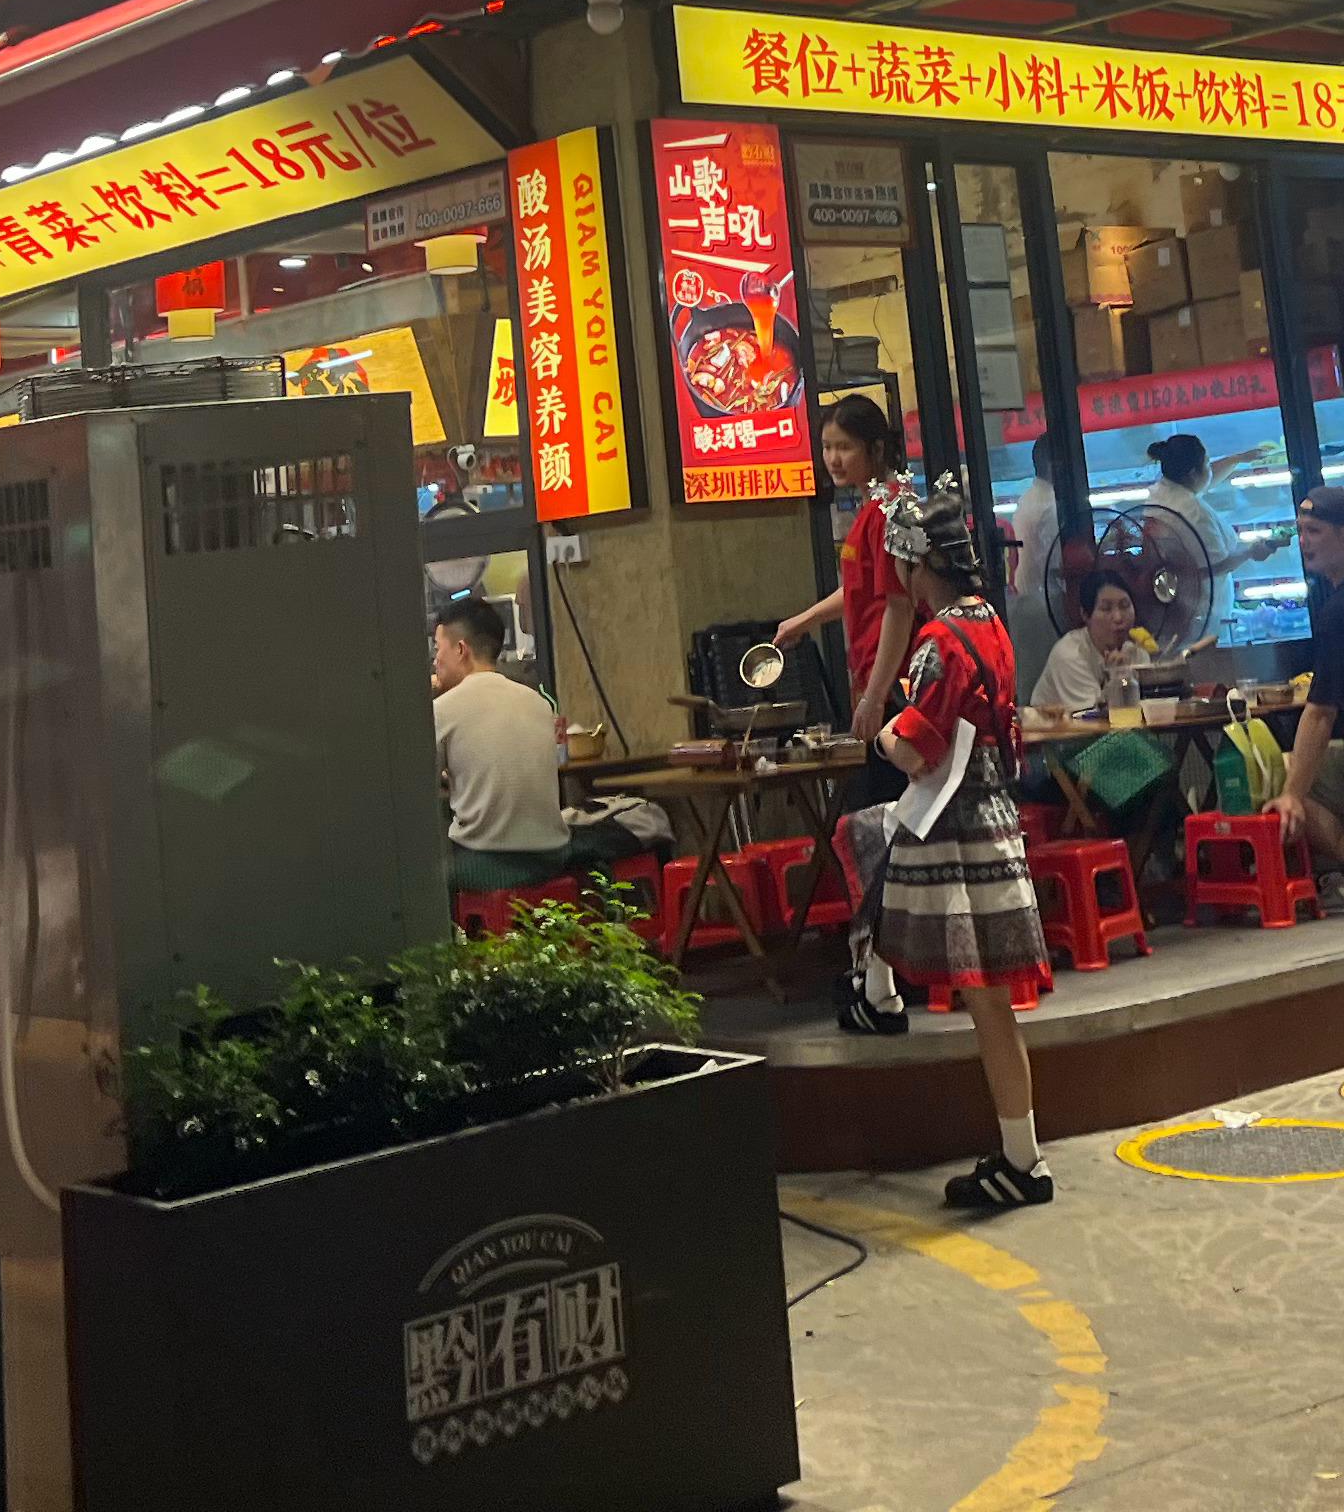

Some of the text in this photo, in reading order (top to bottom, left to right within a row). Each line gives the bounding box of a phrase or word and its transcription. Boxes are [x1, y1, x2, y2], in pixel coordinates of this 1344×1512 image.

[668, 156, 728, 202] 山歌
[415, 193, 502, 230] 400-0097-666
[667, 200, 773, 248] 一声吼
[516, 168, 573, 494] 酸汤美容养颜
[582, 287, 610, 367] YOU
[592, 391, 619, 464] CAI
[693, 418, 795, 454] 酸汤喝一口
[684, 466, 816, 500] 深圳排队王
